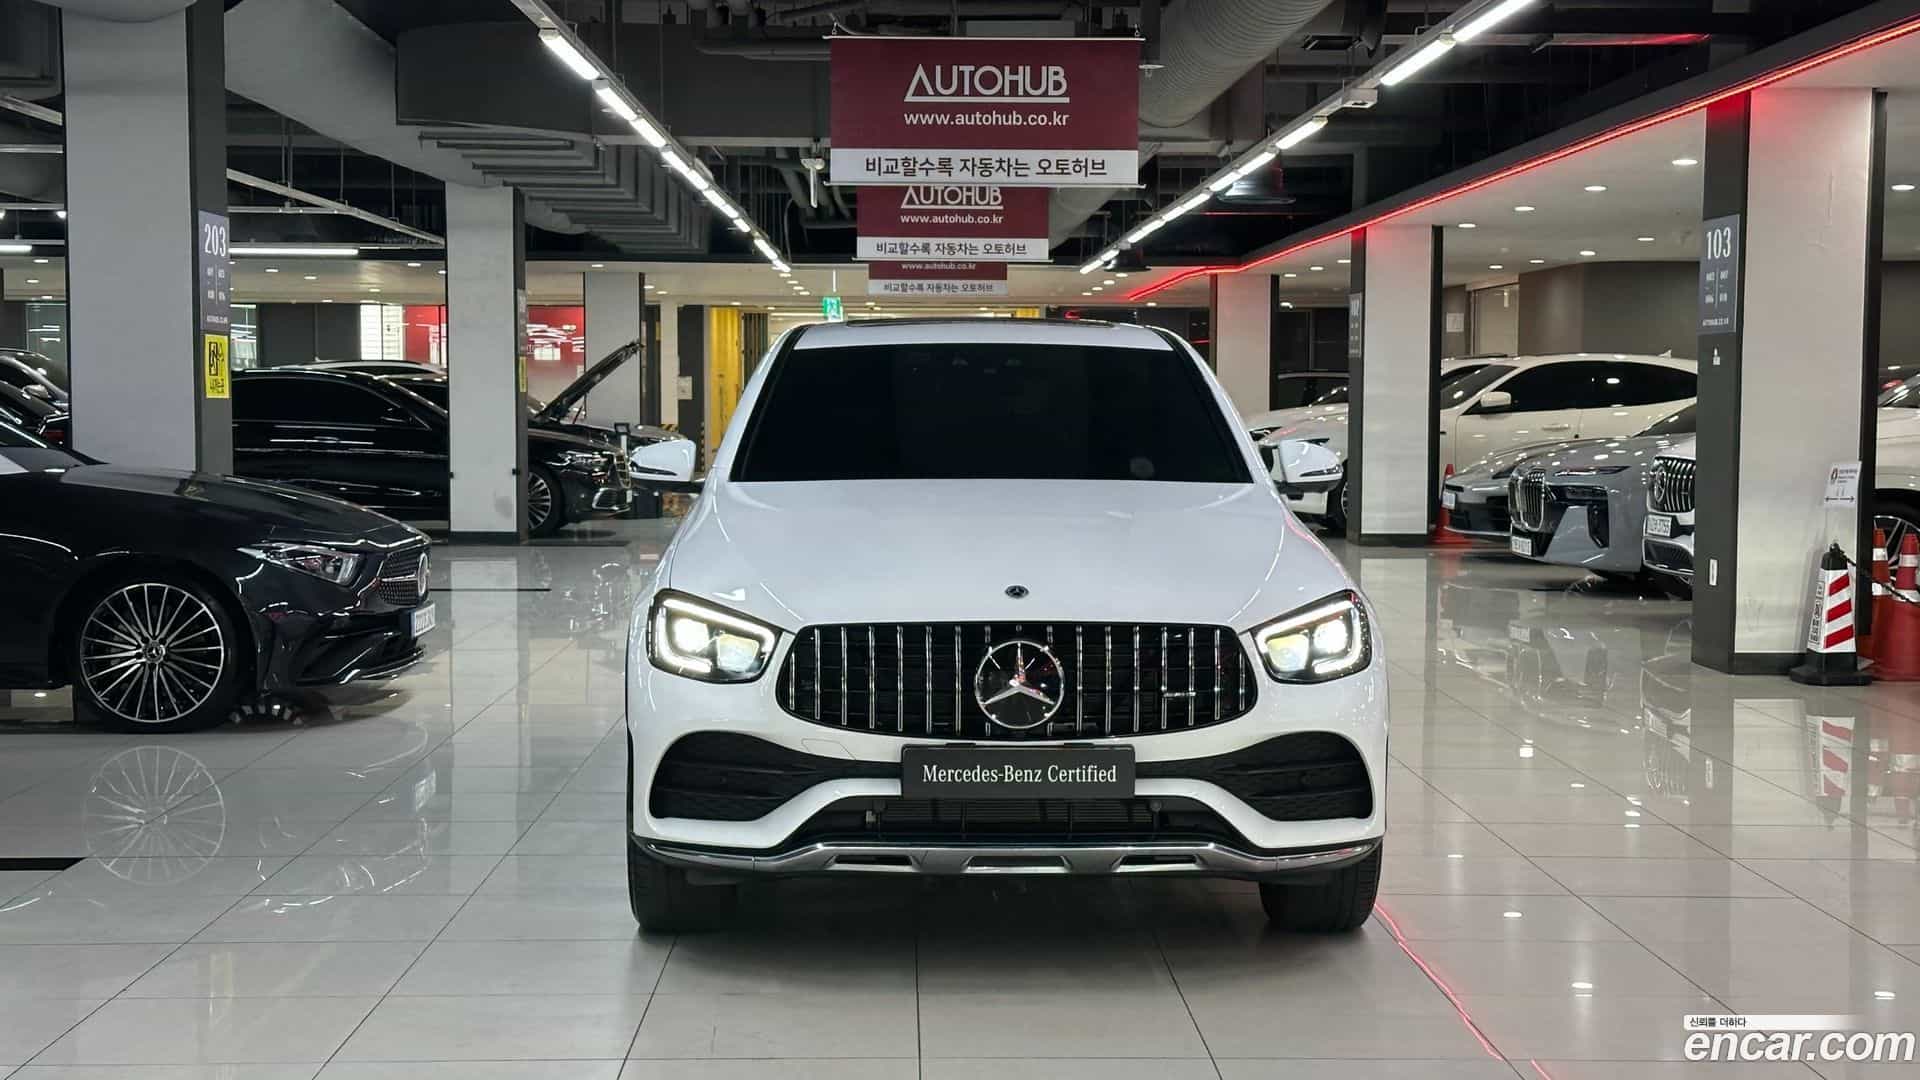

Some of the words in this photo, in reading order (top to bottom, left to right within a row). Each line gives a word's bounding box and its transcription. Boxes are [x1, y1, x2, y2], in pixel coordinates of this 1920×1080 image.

[904, 63, 1070, 103] AUTOHUB
[904, 111, 1070, 126] www.autohub.co.kr
[865, 156, 954, 178] 비교할수록
[959, 156, 1031, 178] 자동차는
[1035, 157, 1107, 178] 오토허브
[901, 186, 1004, 210] AUTOHUB
[900, 213, 1004, 224] www.autohub.co.kr
[204, 223, 226, 257] 203
[876, 242, 931, 256] 비교할수록
[935, 242, 979, 256] 자동차는
[983, 243, 1027, 256] 오토허브
[1706, 227, 1731, 260] 103
[883, 283, 925, 293] 비교할수록
[926, 283, 960, 293] 자동차는
[962, 283, 993, 293] 오토허브
[922, 764, 1042, 784] Mercedes-Benz
[1047, 764, 1117, 784] Certified
